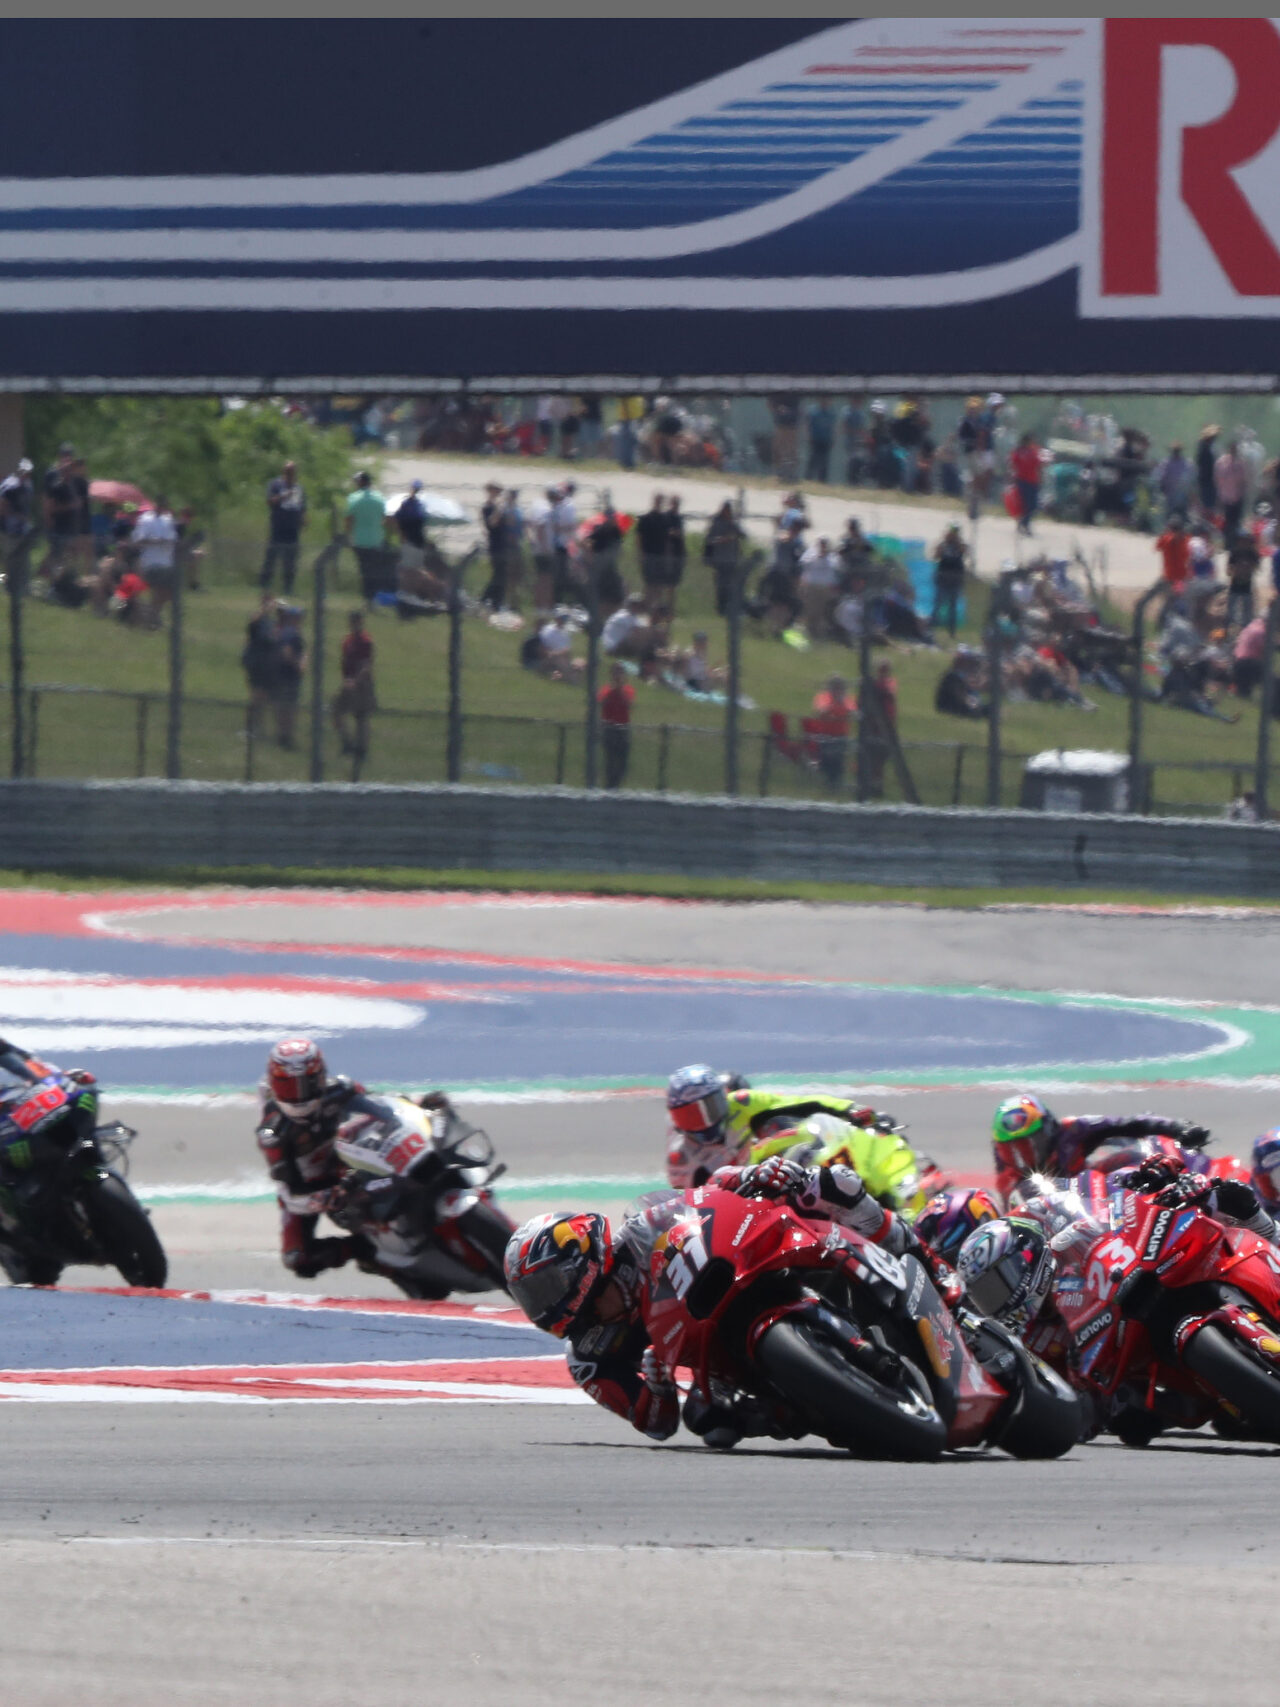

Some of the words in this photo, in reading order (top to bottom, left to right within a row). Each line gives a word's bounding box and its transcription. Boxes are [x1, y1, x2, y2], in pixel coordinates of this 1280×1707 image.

[731, 1213, 754, 1247] GASGAS
[1142, 1210, 1171, 1261] Lenovo
[666, 1235, 708, 1301] 31
[1087, 1237, 1136, 1301] 23
[1075, 1312, 1112, 1347] Lenovo
